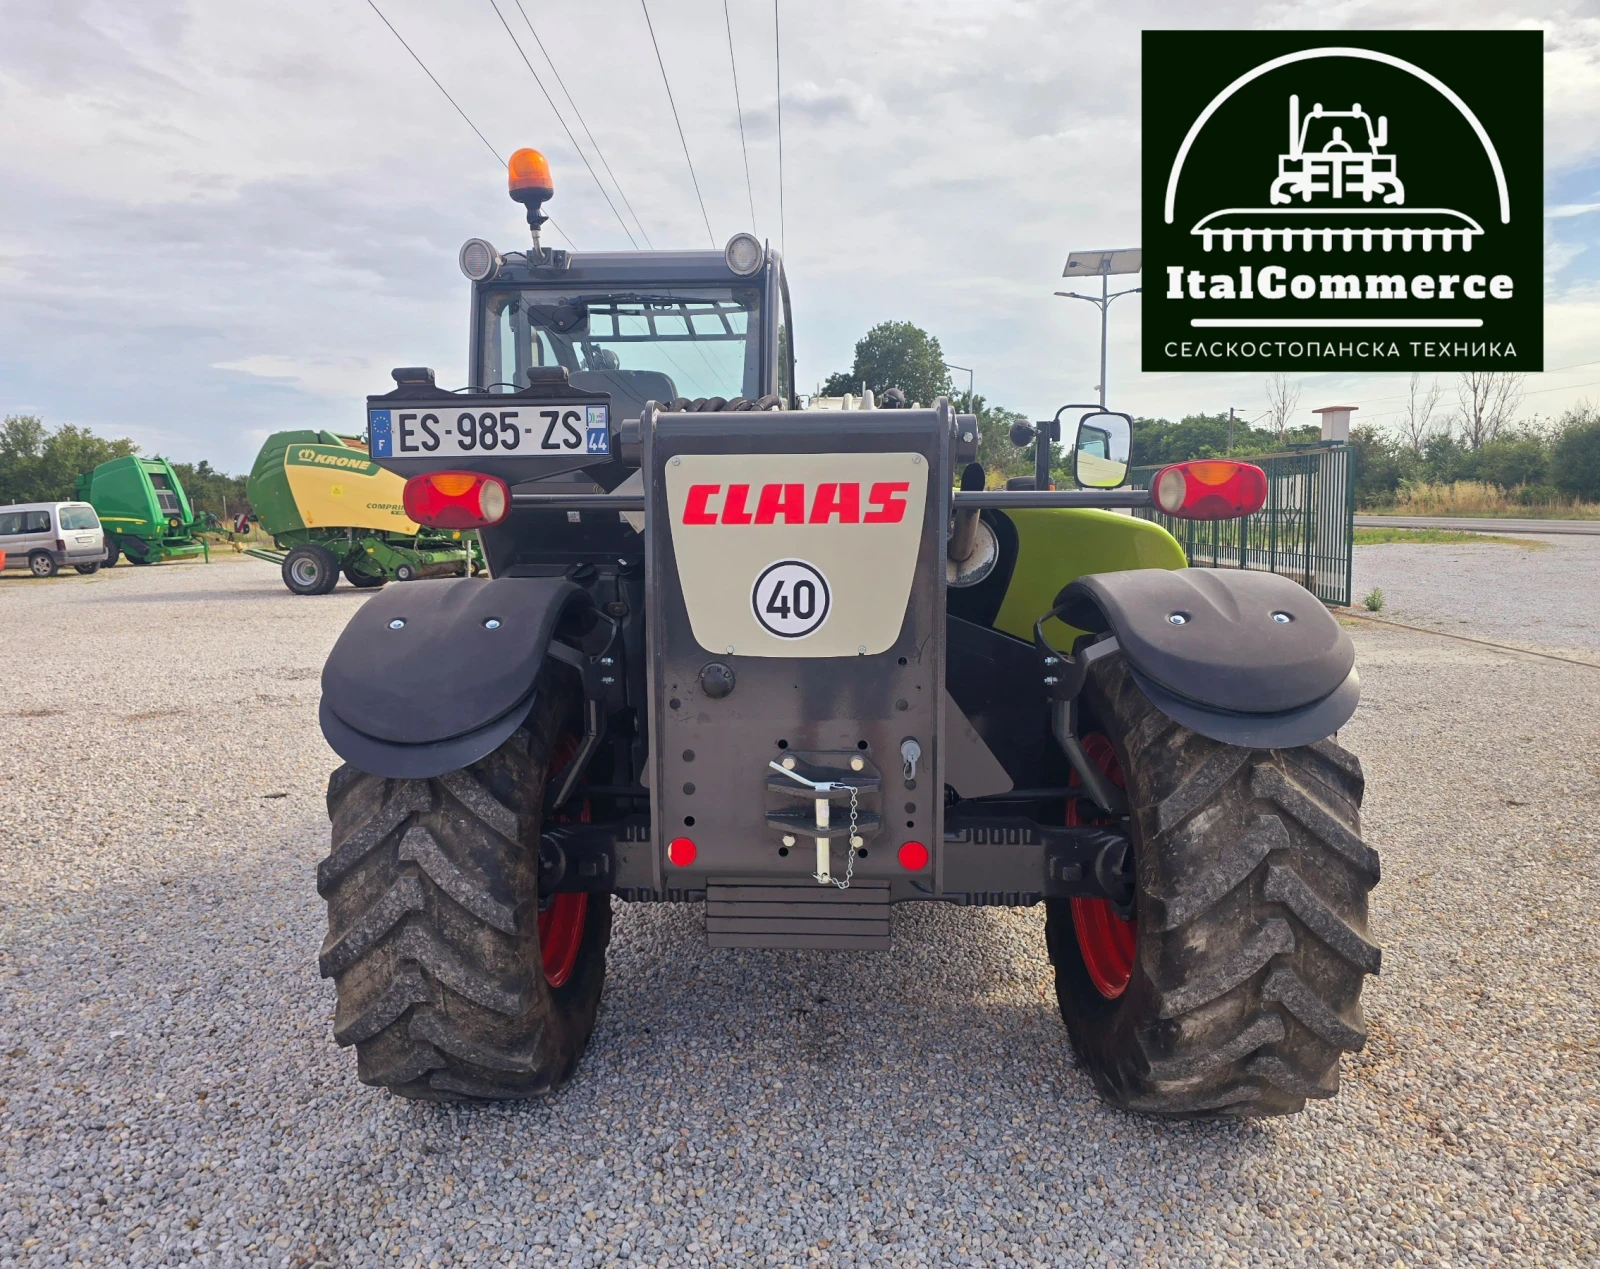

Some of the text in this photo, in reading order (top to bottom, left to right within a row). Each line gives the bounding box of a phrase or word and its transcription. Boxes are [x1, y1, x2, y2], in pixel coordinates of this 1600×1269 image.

[378, 439, 386, 451] F
[398, 410, 583, 452] ES-985-ZS
[588, 432, 607, 451] 44
[314, 454, 371, 470] KRONE
[682, 481, 911, 525] CLAAS
[766, 579, 816, 620] 40
